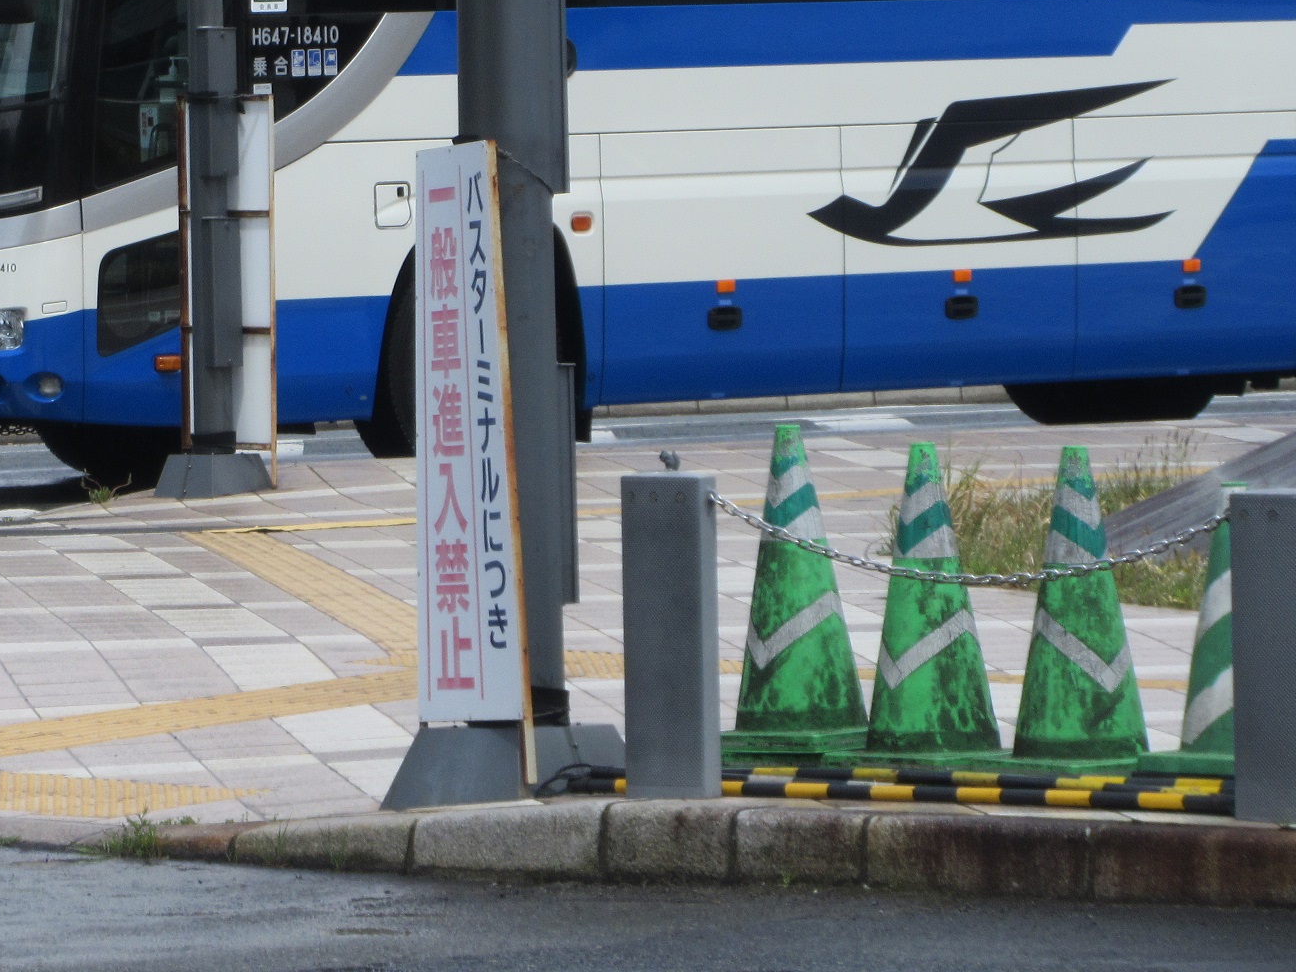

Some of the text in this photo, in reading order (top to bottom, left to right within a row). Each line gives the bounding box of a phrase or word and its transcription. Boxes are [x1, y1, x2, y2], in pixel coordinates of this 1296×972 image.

[252, 26, 339, 46] H647-18410
[429, 186, 475, 690] 一般車進入禁止
[467, 171, 508, 649] バスターミナルにつき
